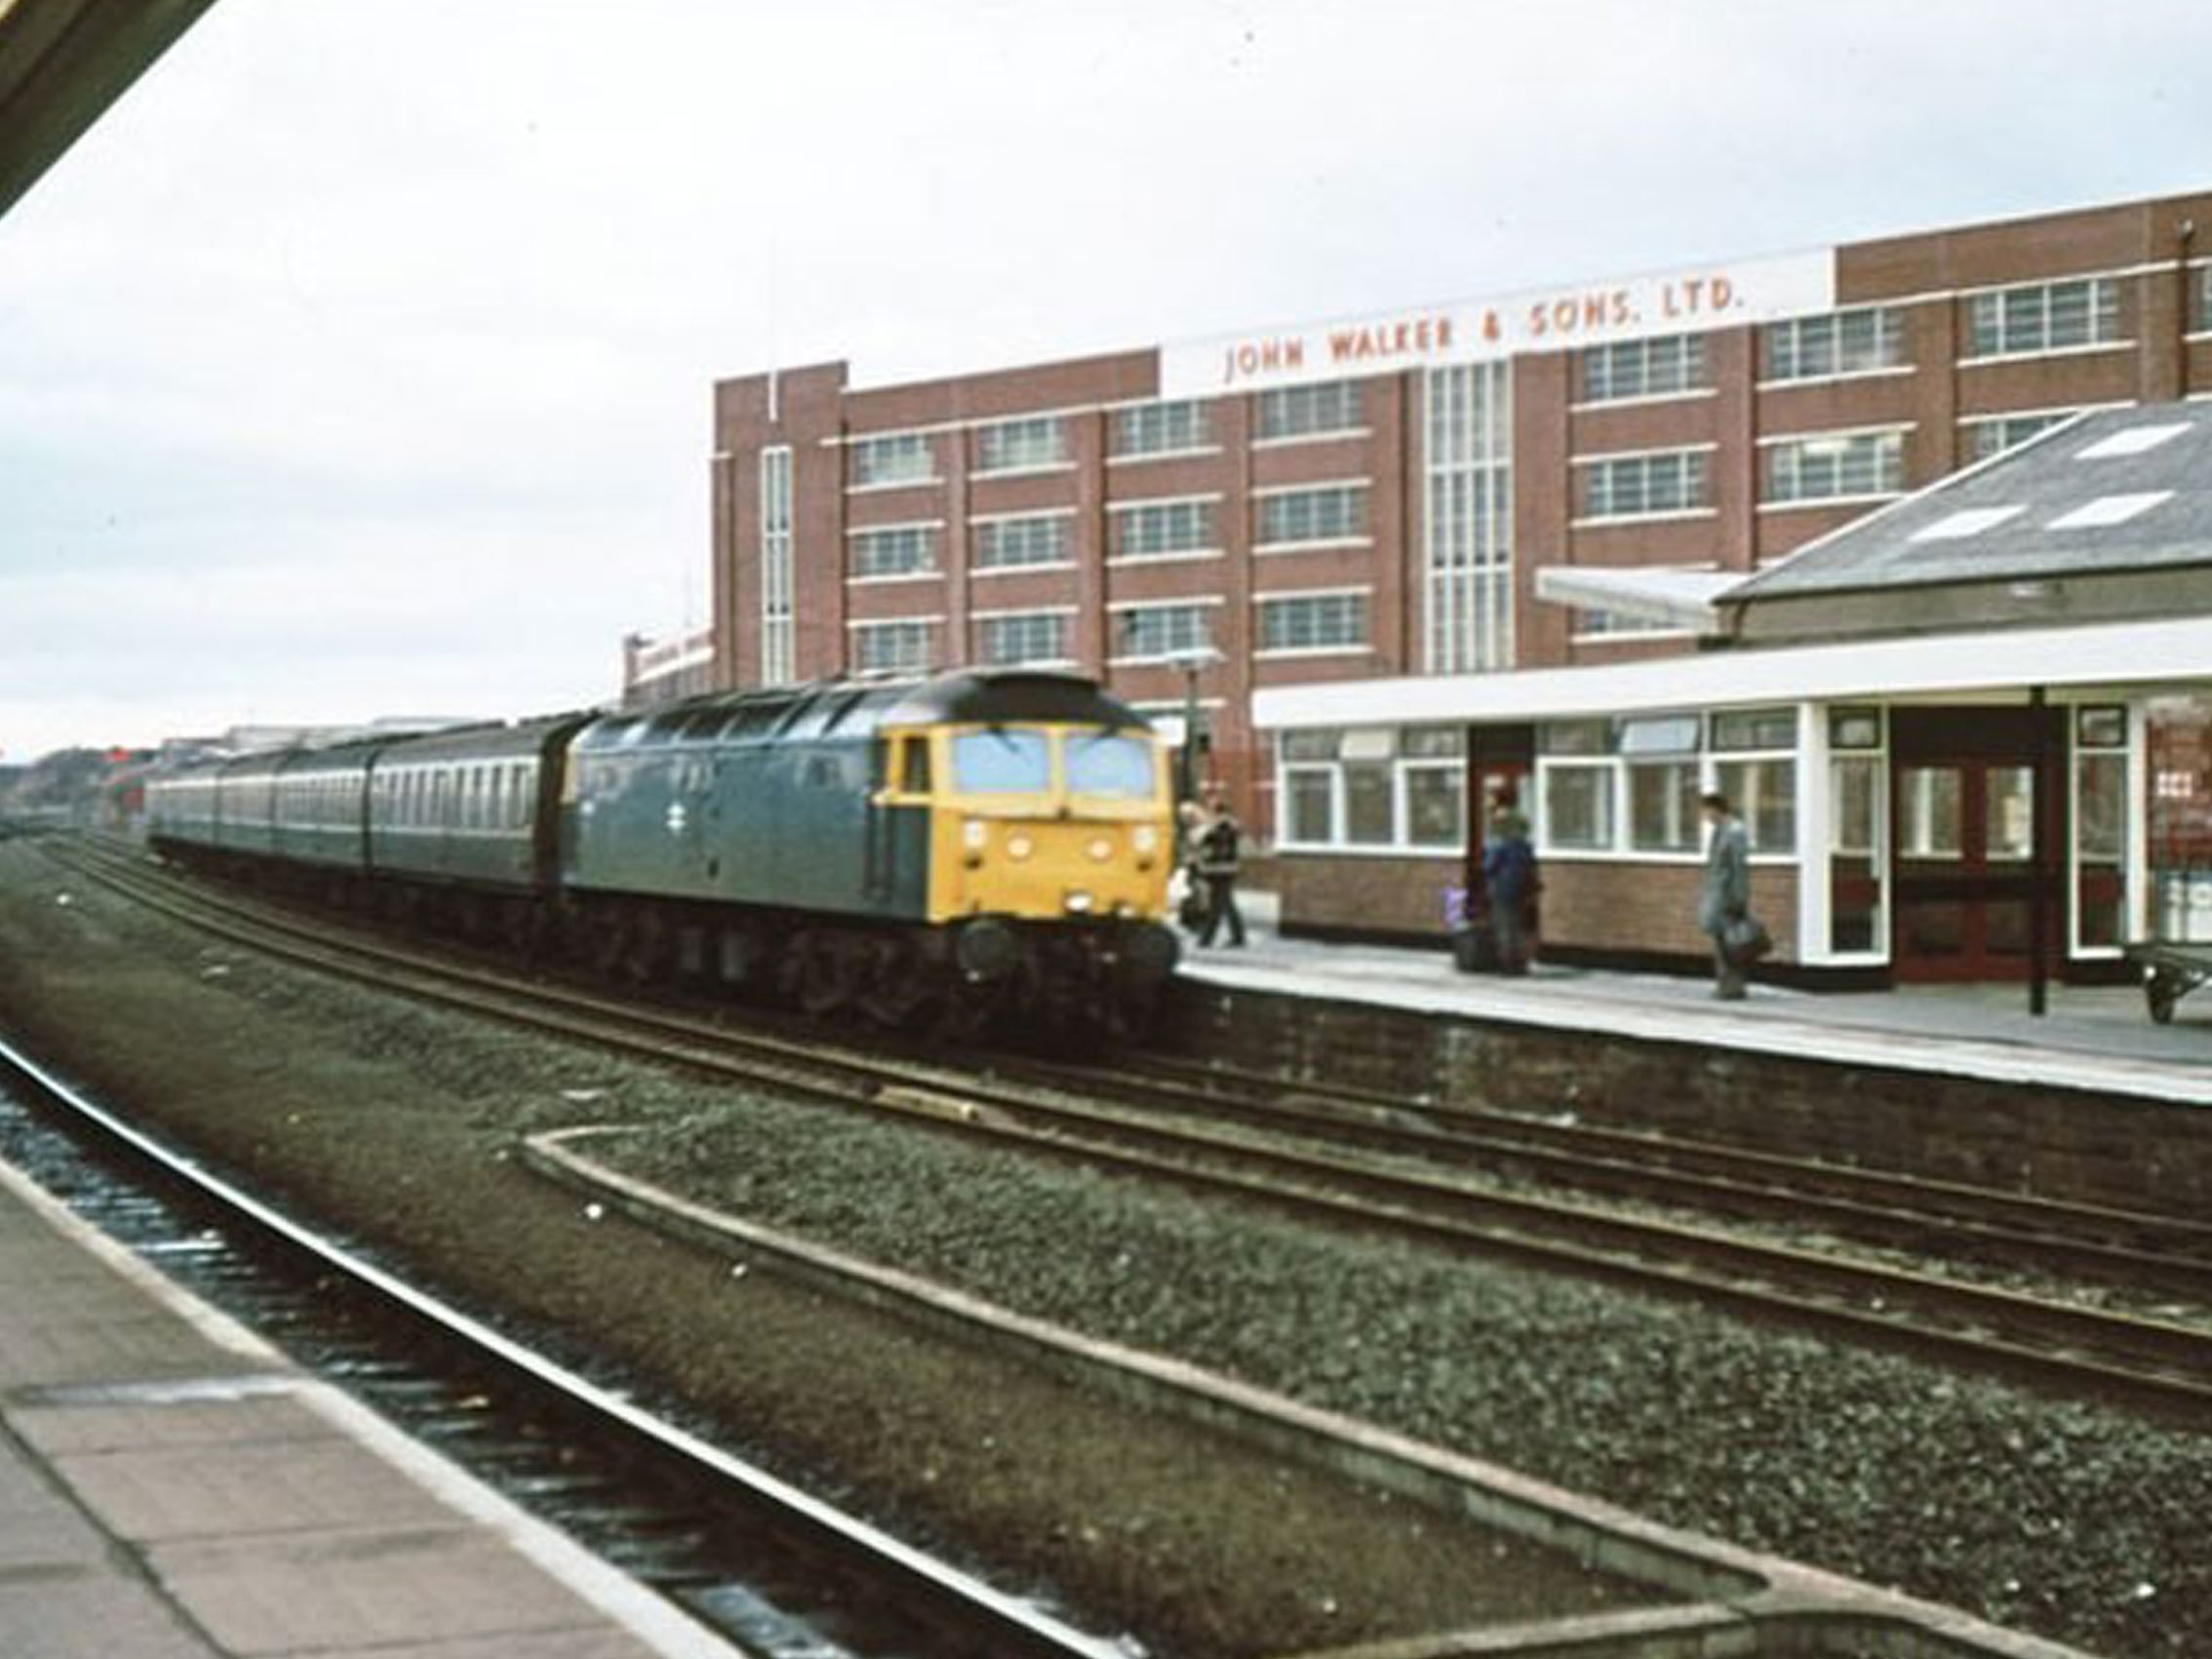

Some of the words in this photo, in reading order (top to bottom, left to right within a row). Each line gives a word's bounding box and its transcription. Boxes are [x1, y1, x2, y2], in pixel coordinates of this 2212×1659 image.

[1224, 338, 1303, 383] JOHN
[1329, 318, 1451, 362] WALKER
[1482, 310, 1500, 341] &
[1662, 276, 1744, 316] LTD.
